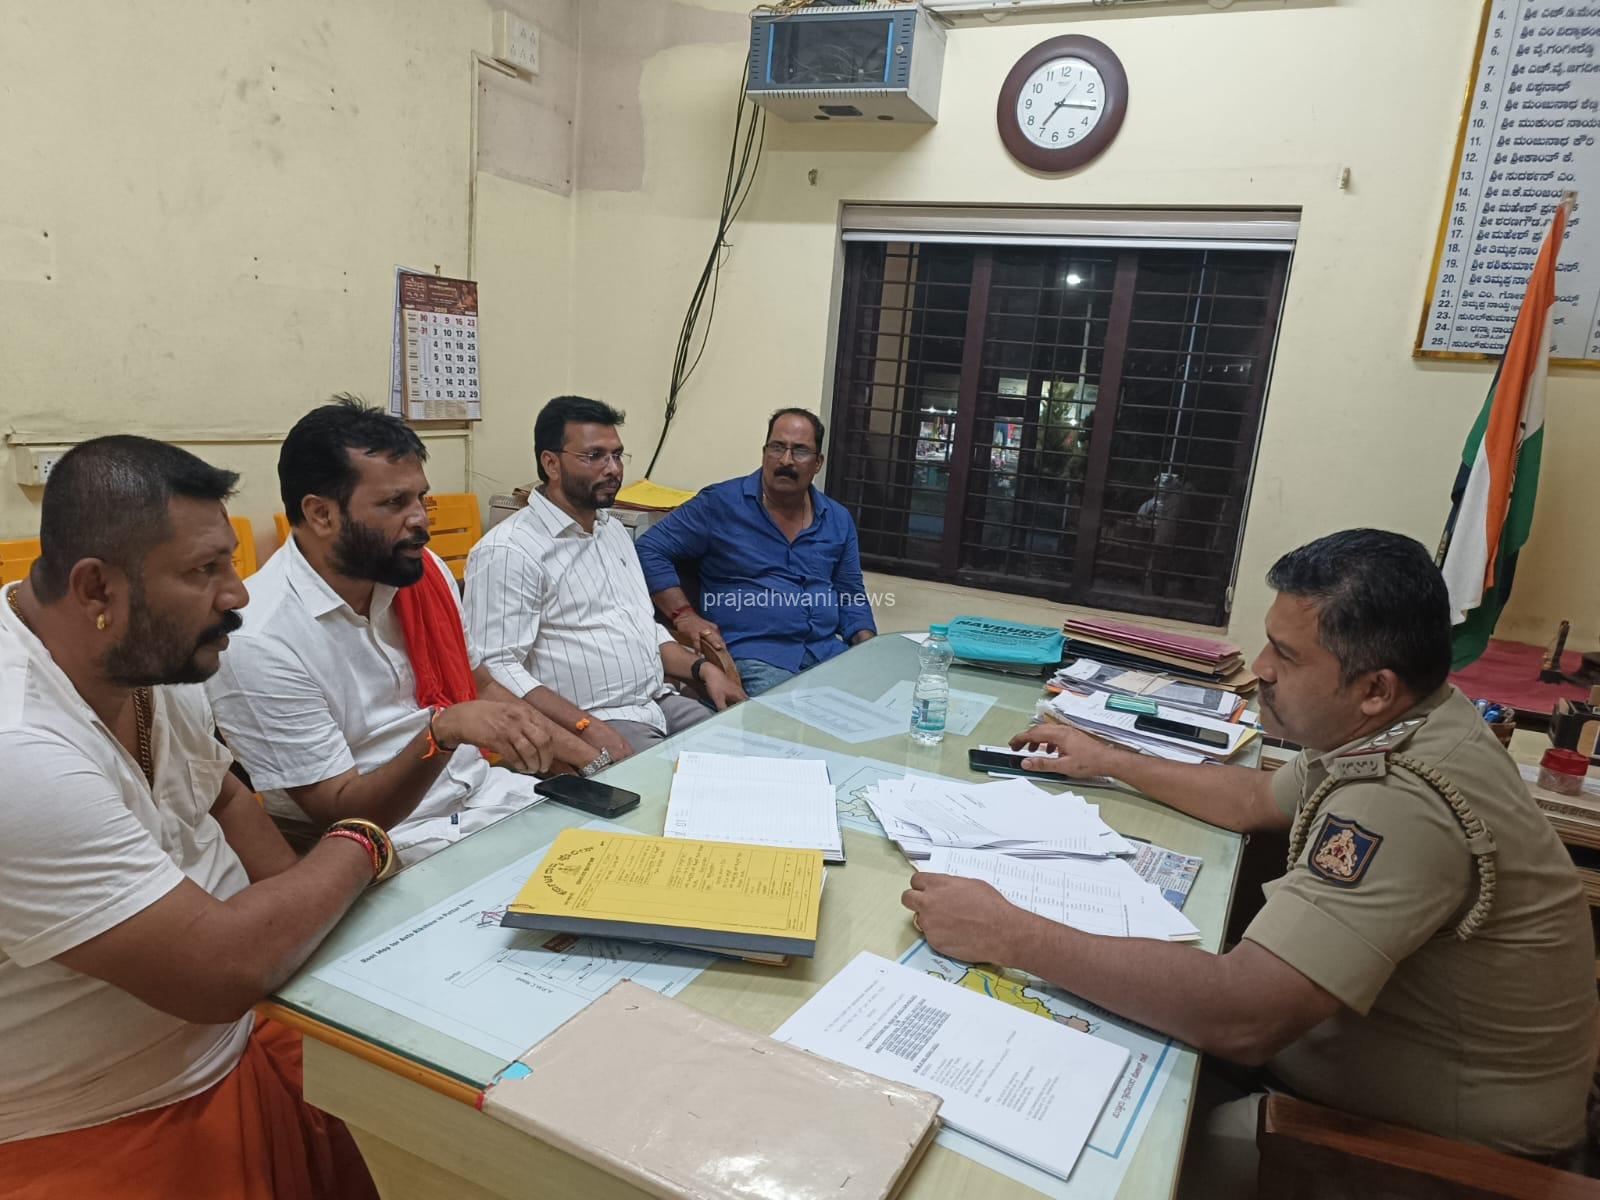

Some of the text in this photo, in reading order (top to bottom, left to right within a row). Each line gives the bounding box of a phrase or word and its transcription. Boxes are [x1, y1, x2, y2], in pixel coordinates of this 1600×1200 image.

[1498, 10, 1506, 20] 4.
[1523, 8, 1538, 21] ಶ್ರೀ
[1494, 28, 1503, 38] 5.
[1520, 26, 1534, 39] ಶ್ರೀ
[1490, 46, 1499, 56] 6.
[1515, 44, 1530, 57] ಶ್ರೀ
[1046, 71, 1054, 81] 11
[1061, 66, 1072, 77] 12
[1079, 71, 1083, 81] 1
[1487, 65, 1495, 76] 7.
[1511, 64, 1526, 77] ಶ್ರೀ
[1032, 82, 1043, 94] 10
[1086, 82, 1095, 94] 2
[1483, 83, 1492, 93] 8.
[1508, 81, 1522, 95] ಶ್ರೀ
[1025, 98, 1032, 110] 9
[1480, 100, 1488, 110] 9.
[1504, 99, 1519, 112] ಶ್ರೀ
[1027, 115, 1035, 126] 8
[1081, 116, 1088, 127] 4
[1472, 118, 1485, 128] 10.
[1501, 117, 1515, 130] ಶ್ರೀ
[1039, 127, 1046, 138] 7
[1051, 131, 1059, 142] 6
[1067, 127, 1075, 138] 5
[1470, 137, 1481, 146] 11.
[1496, 135, 1511, 147] ಶ್ರೀ
[1465, 153, 1478, 163] 12.
[1493, 152, 1508, 165] ಶ್ರೀ
[1461, 171, 1474, 181] 13.
[1489, 170, 1503, 182] ಶ್ರೀ
[1459, 188, 1471, 197] 14.
[1484, 186, 1499, 198] ಶ್ರೀ
[1455, 202, 1467, 212] 15.
[1482, 202, 1496, 214] ಶ್ರೀ
[1453, 217, 1465, 226] 16.
[1480, 216, 1493, 227] ಶ್ರೀ
[1451, 229, 1463, 239] 17.
[1476, 229, 1490, 241] ಶ್ರೀ
[1448, 244, 1461, 253] 18.
[1473, 243, 1488, 255] ಶ್ರೀ
[1446, 259, 1459, 269] 19.
[1470, 259, 1485, 271] ಶ್ರೀ
[1442, 274, 1457, 284] 20.
[1468, 273, 1483, 285] ಶ್ರೀ
[1440, 290, 1453, 298] 21.
[1438, 300, 1454, 308] 22.
[1436, 311, 1451, 319] 23.
[467, 319, 475, 327] 23
[1434, 323, 1450, 331] 24.
[443, 329, 452, 337] 10
[467, 331, 475, 339] 24
[467, 343, 475, 351] 25
[1431, 338, 1447, 346] 25.
[434, 353, 438, 361] 5
[467, 355, 476, 363] 26
